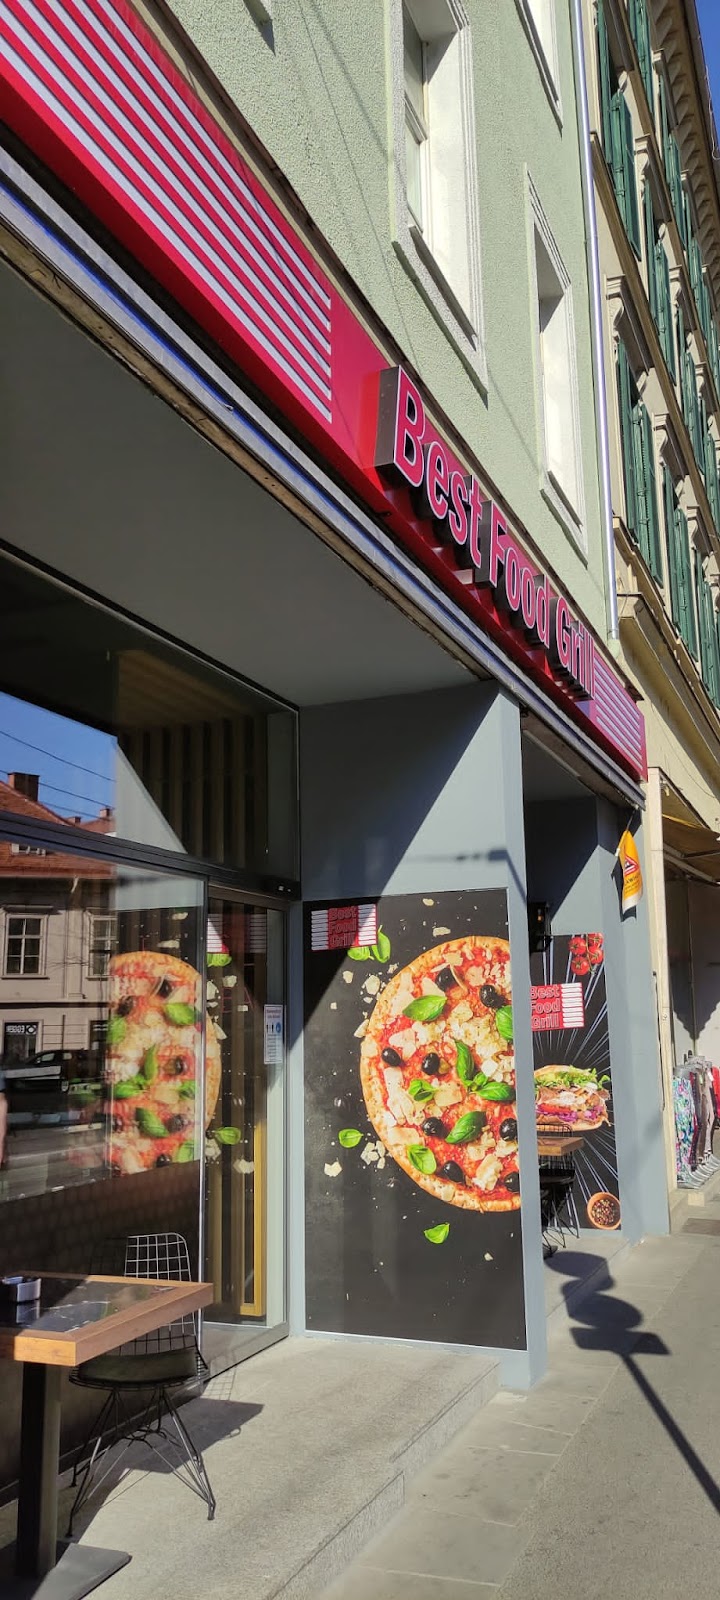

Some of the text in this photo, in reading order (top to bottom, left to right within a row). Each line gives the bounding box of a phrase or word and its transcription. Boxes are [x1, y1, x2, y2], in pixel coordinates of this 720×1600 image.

[394, 365, 596, 699] Best Food Grill
[530, 984, 560, 999] Best
[531, 1013, 560, 1029] Grill
